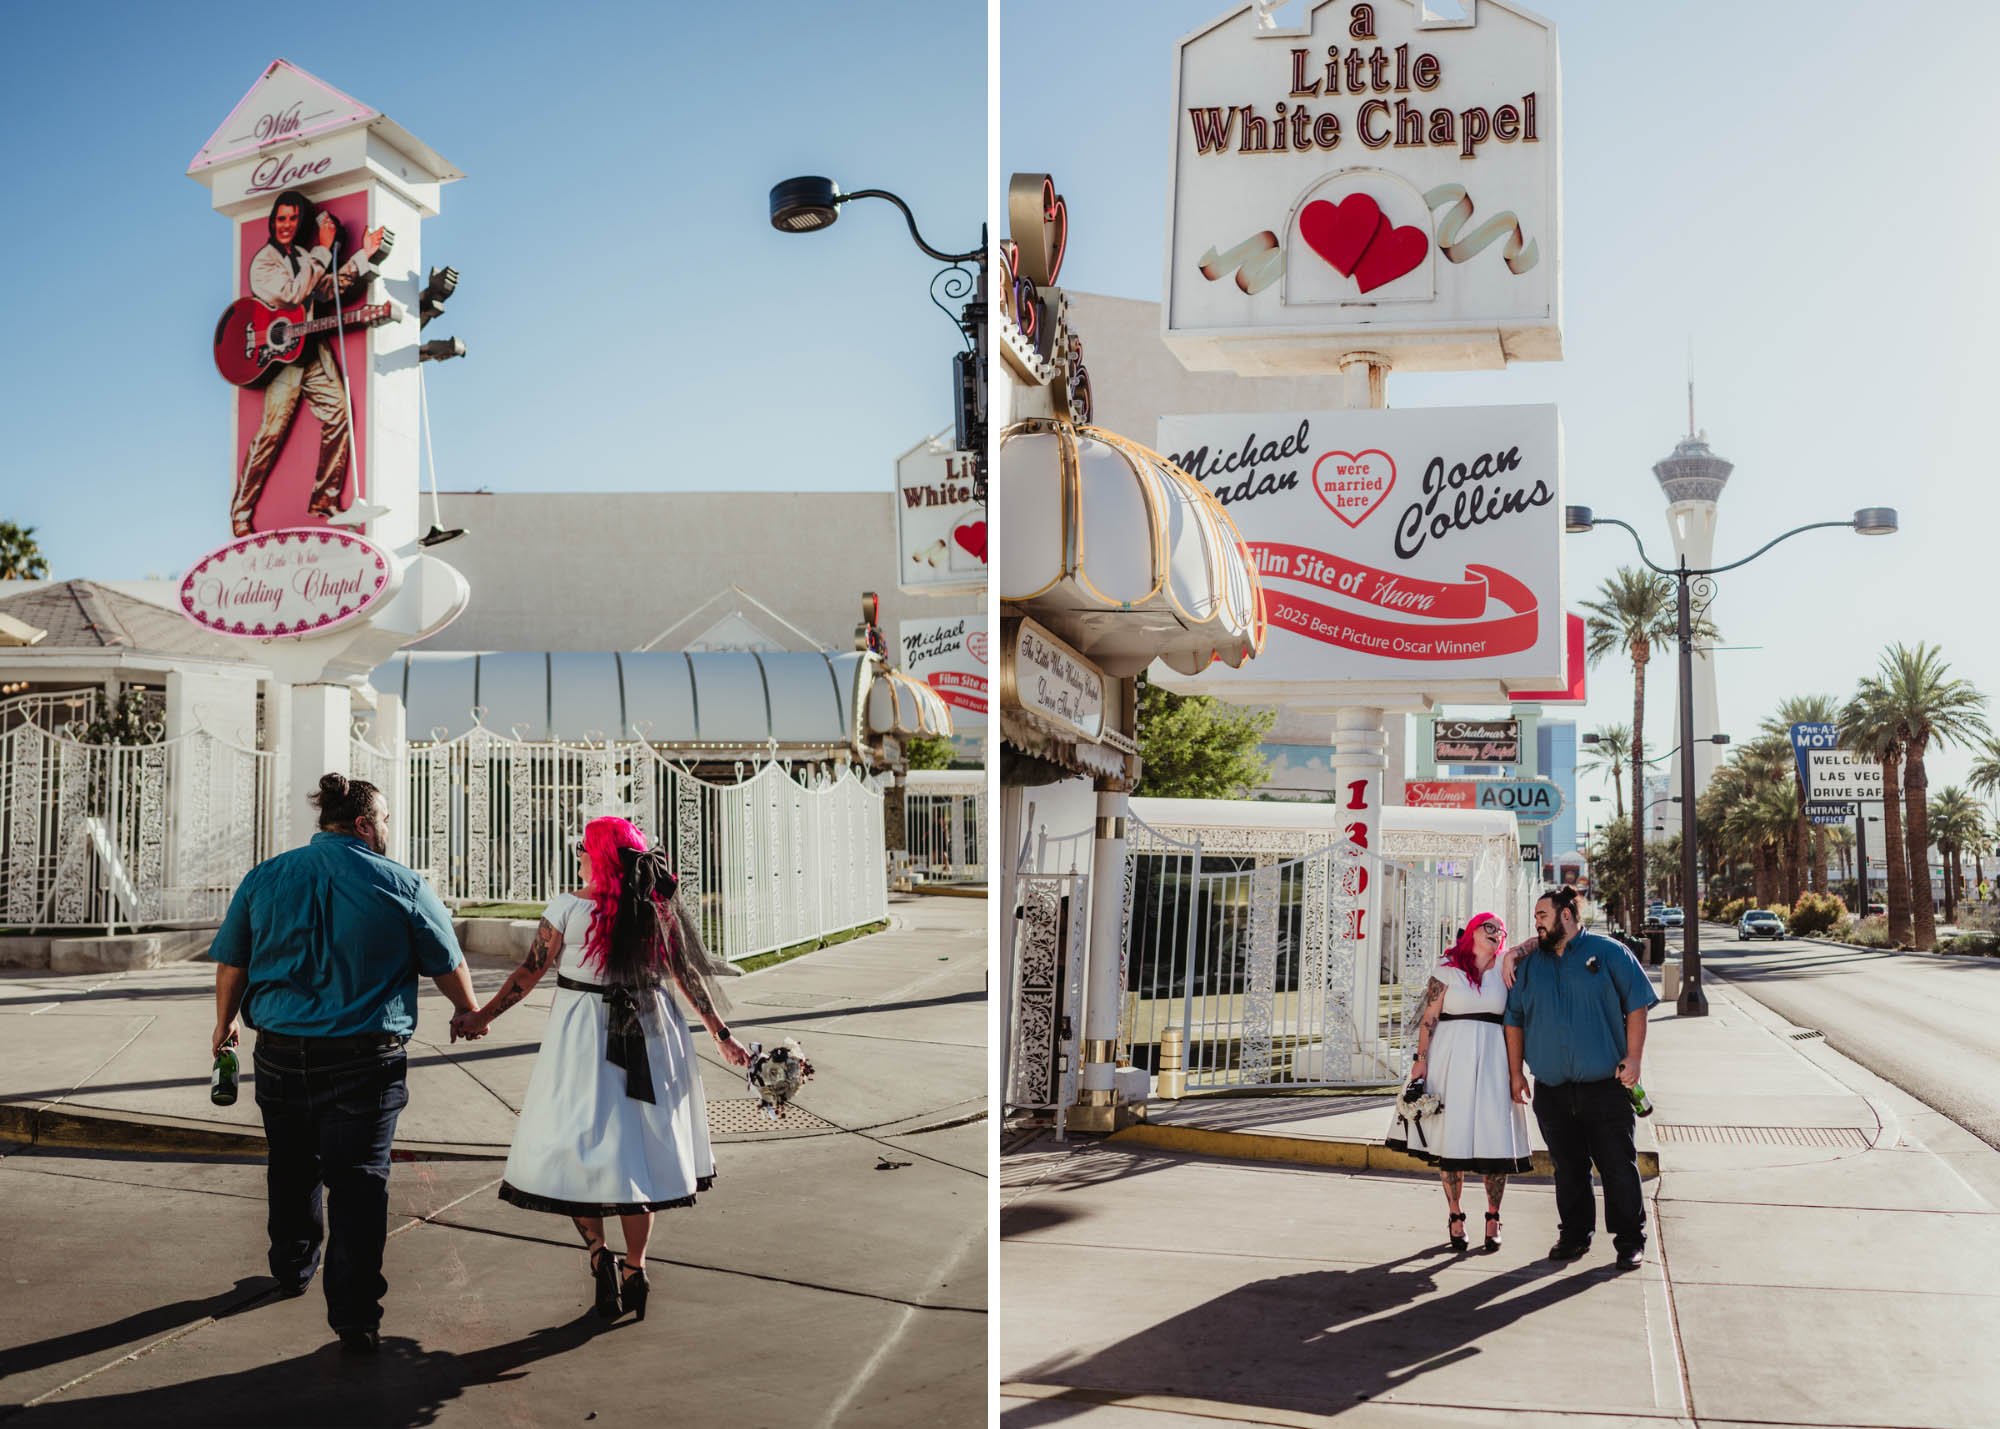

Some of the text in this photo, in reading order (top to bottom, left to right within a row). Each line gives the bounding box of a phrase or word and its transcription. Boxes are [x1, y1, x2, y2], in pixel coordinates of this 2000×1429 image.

[1349, 3, 1376, 40] a
[1289, 43, 1442, 98] Little
[254, 101, 303, 141] With
[1188, 92, 1540, 160] White Chapel
[244, 153, 332, 194] Love
[1167, 419, 1310, 482] Michael
[1324, 477, 1382, 492] married
[1336, 465, 1371, 475] were
[1422, 445, 1522, 516] Joan
[903, 483, 970, 508] White
[1215, 469, 1299, 506] rdan
[1336, 495, 1369, 507] here
[1394, 479, 1554, 560] Collins
[1293, 554, 1336, 585] Site
[1339, 571, 1367, 594] of
[198, 568, 364, 612] Wedding Chapel
[903, 619, 965, 650] Michael
[1274, 604, 1487, 654] 2025 Best Picture Oscar Winner
[908, 641, 961, 670] Jordan
[939, 673, 960, 685] Film
[961, 675, 980, 688] Site
[1447, 723, 1506, 739] Shalimar
[1797, 734, 1840, 747] MOT
[1820, 772, 1880, 781] LAS VEG
[1406, 783, 1466, 803] Shalimar
[1481, 787, 1550, 808] AQUA
[1814, 788, 1852, 797] DRIVE
[1805, 805, 1852, 815] ENTRANCE
